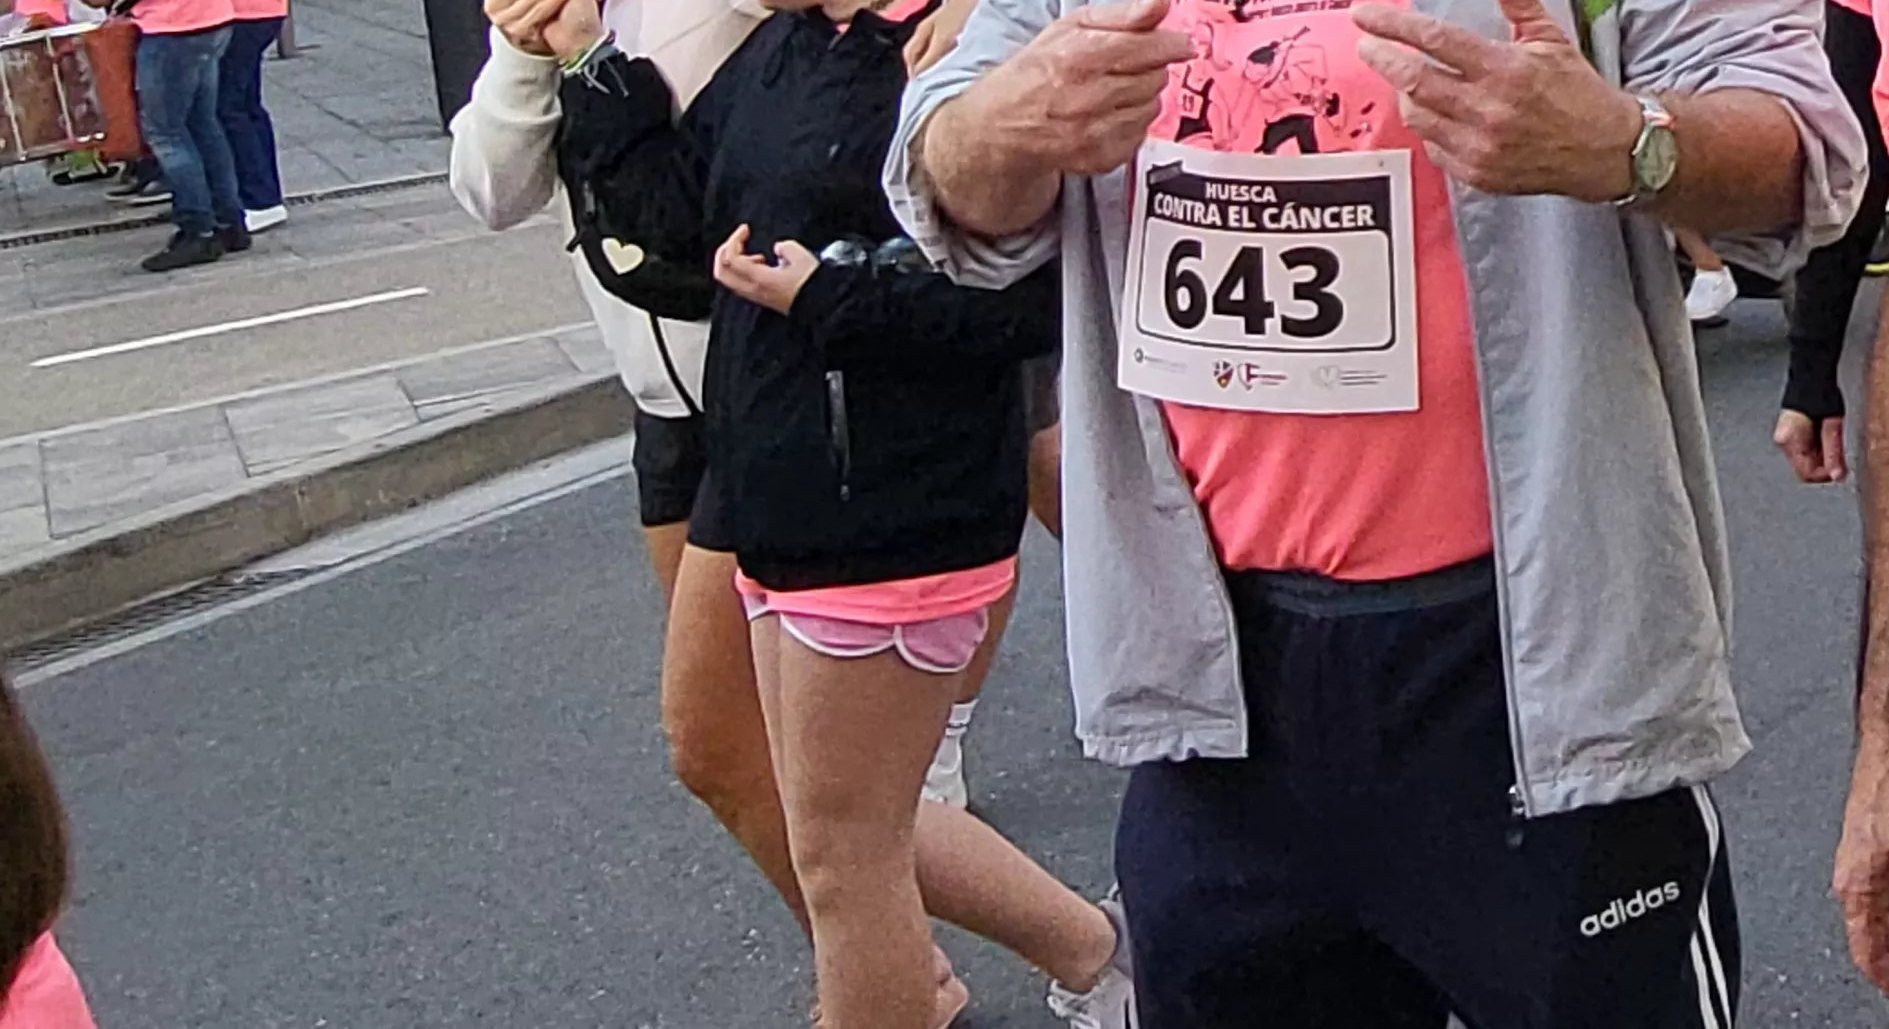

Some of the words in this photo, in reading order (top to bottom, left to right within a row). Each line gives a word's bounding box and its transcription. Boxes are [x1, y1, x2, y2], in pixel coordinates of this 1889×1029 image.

[1154, 192, 1222, 227] CONTRA
[1227, 205, 1256, 229] EL
[1262, 201, 1376, 229] CÁNCER
[1205, 182, 1278, 203] HUESCA
[1164, 239, 1344, 339] 643
[1579, 881, 1681, 937] adidas
